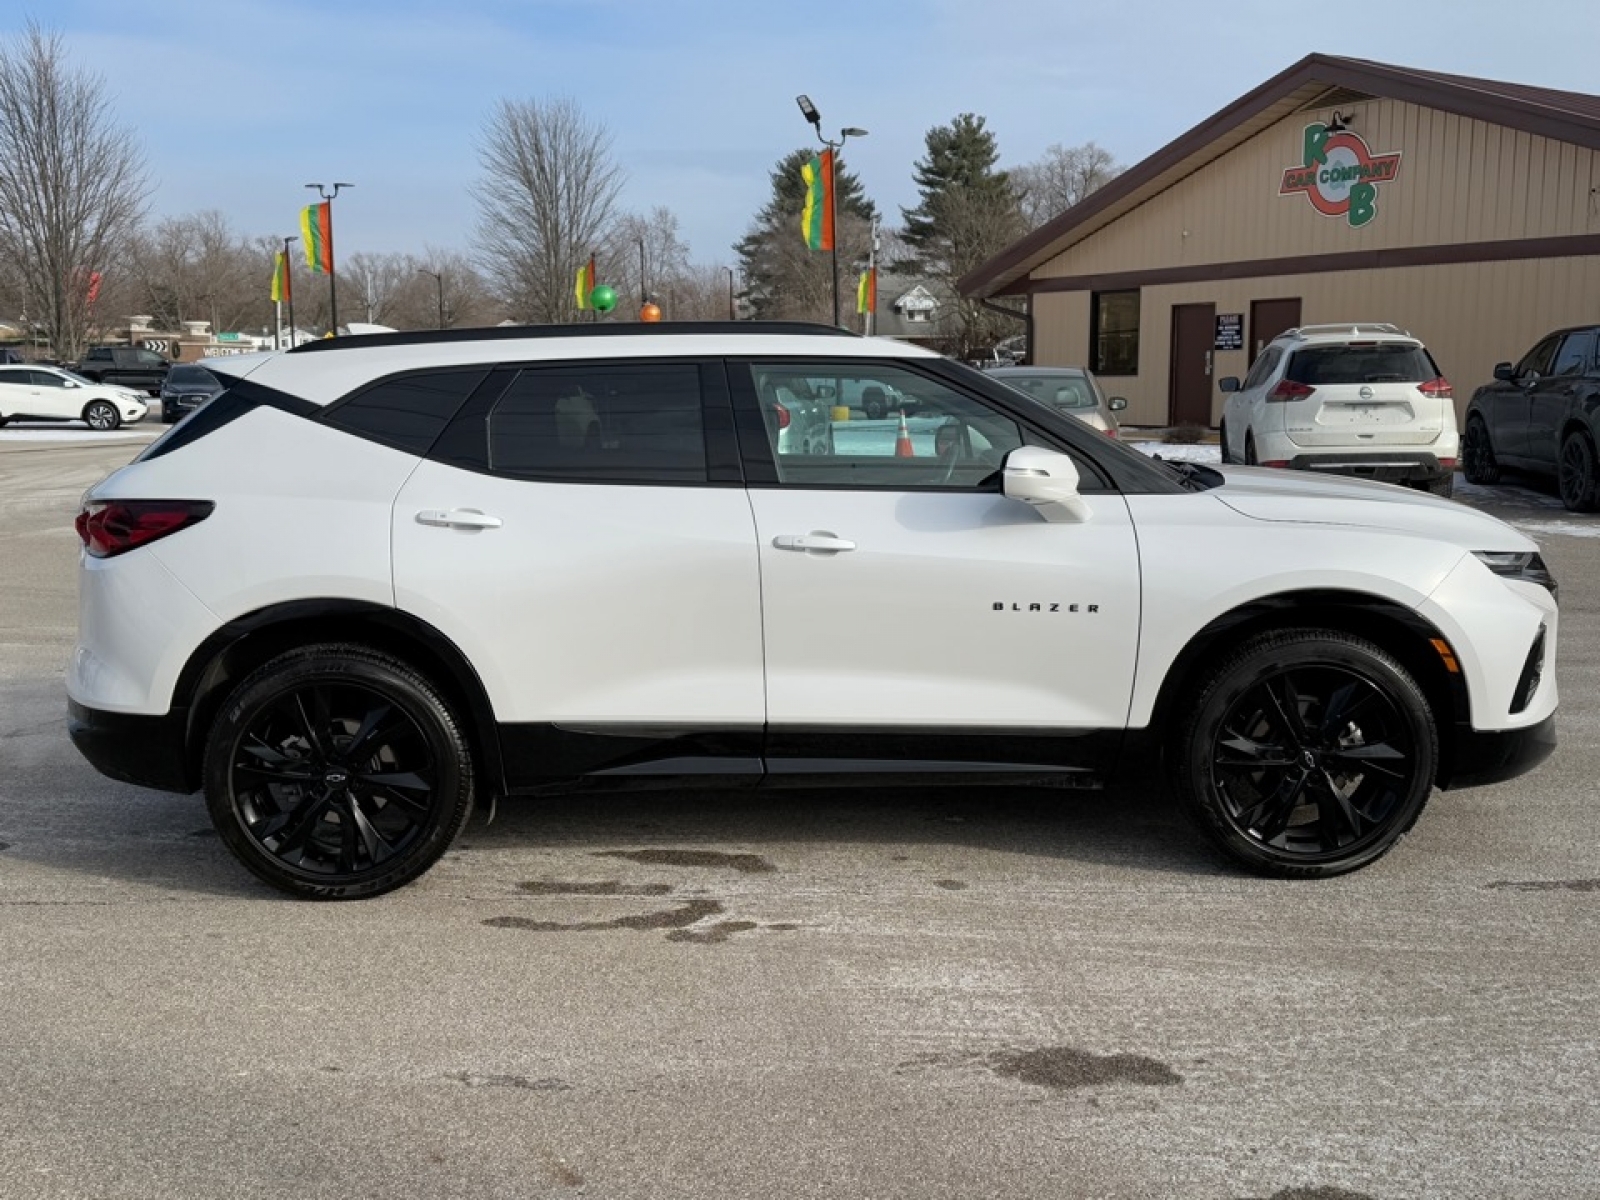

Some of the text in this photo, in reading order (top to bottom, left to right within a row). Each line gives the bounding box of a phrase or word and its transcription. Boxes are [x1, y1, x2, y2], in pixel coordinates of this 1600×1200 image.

[1286, 160, 1395, 188] CAR COMPANY
[1349, 182, 1376, 227] B
[992, 601, 1100, 613] BLAZER
